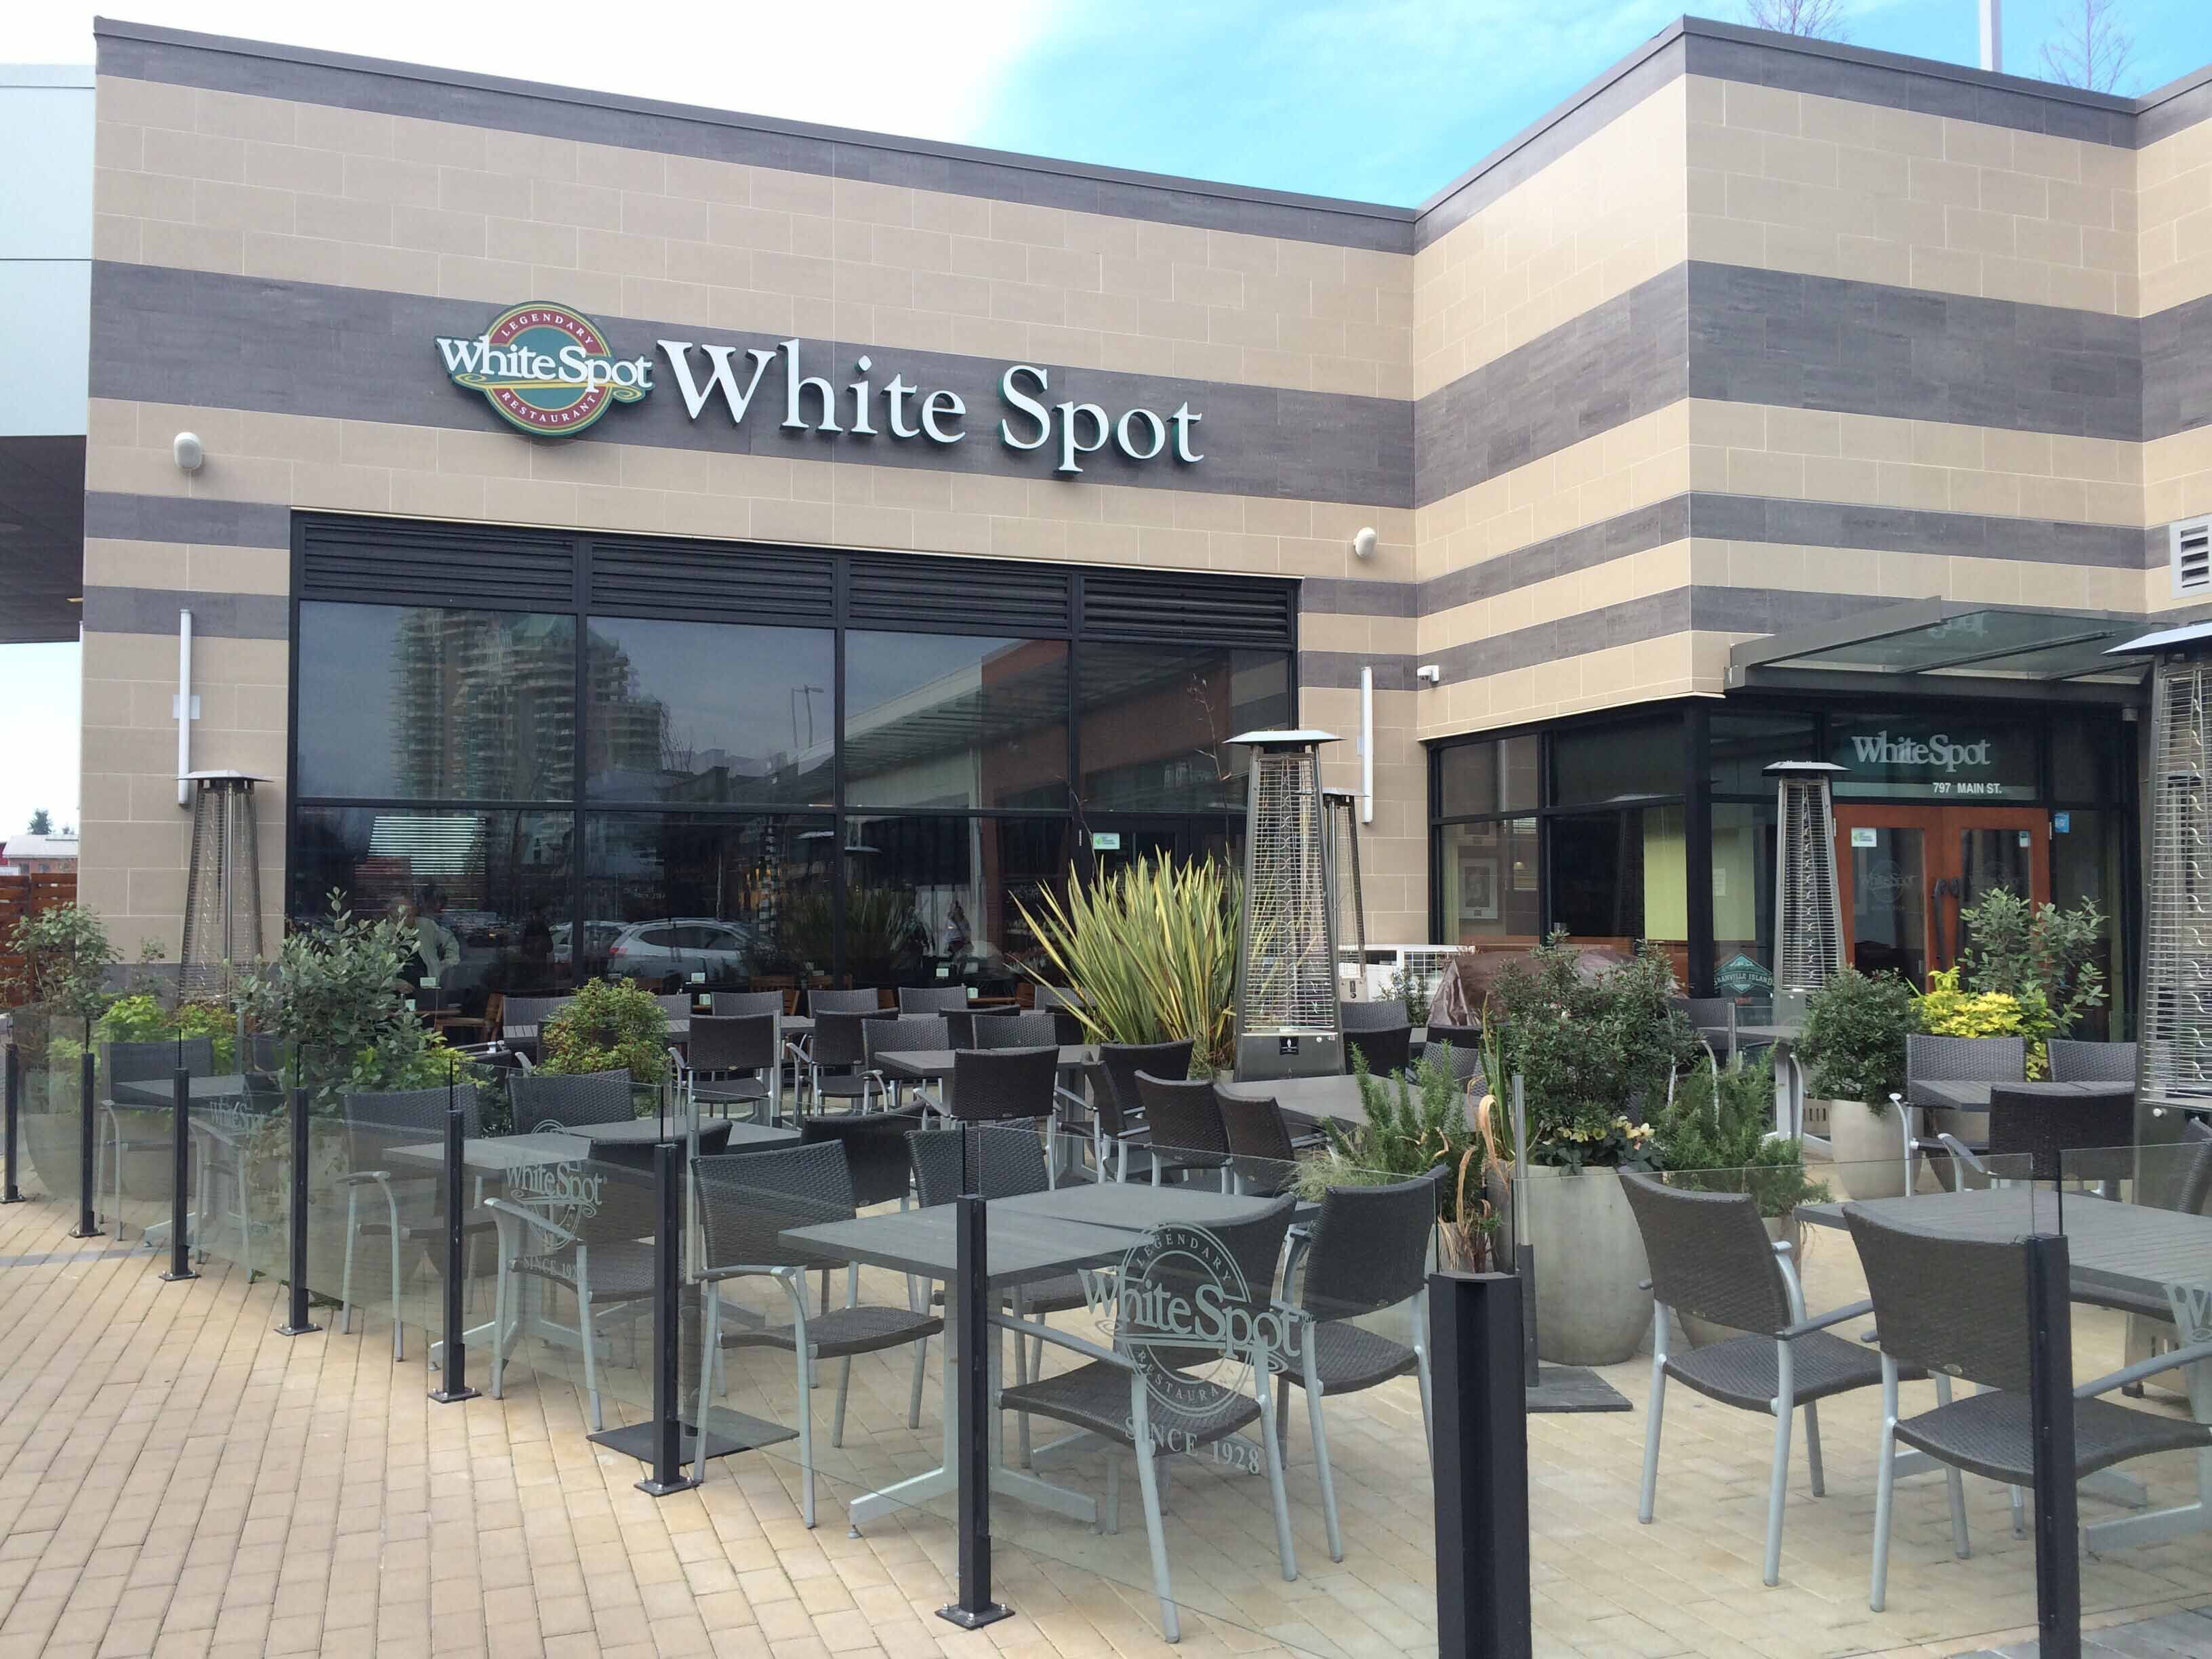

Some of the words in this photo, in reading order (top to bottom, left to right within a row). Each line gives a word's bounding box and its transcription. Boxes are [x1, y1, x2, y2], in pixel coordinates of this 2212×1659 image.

[500, 312, 594, 346] LEGENDARY
[501, 391, 596, 423] RESTAURANT
[655, 338, 966, 444] White
[999, 364, 1205, 474] Spot
[1932, 782, 1952, 794] 797
[1957, 782, 1984, 795] MAIN
[1986, 783, 2003, 795] ST.
[1748, 973, 1774, 986] ISLAND
[1136, 1230, 1232, 1282] LEGENDARY
[1124, 1416, 1199, 1457] SNCE
[1209, 1439, 1261, 1475] 1928
